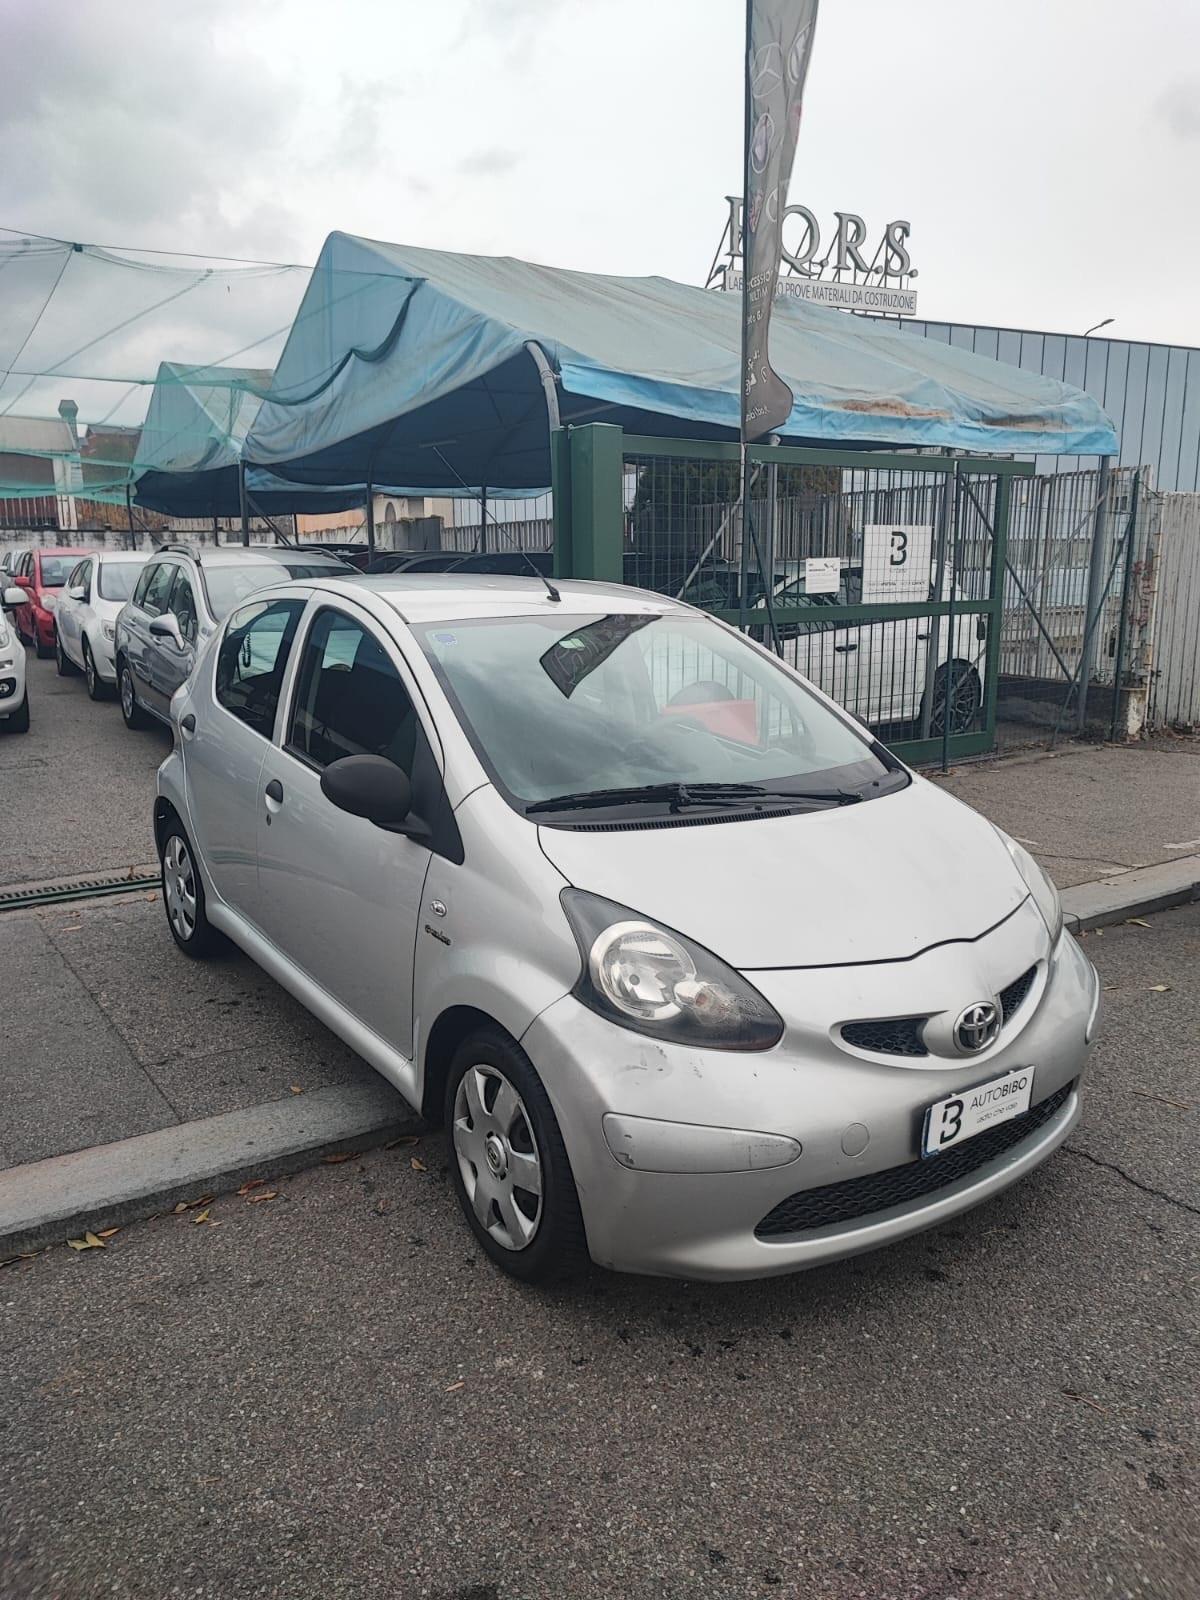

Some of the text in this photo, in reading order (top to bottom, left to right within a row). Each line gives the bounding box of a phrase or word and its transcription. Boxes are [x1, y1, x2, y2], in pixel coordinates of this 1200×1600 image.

[785, 282, 810, 299] PROVE
[812, 285, 851, 303] MATERIALI
[853, 290, 863, 304] DA
[864, 291, 914, 310] COSTRUZIONE
[970, 1076, 1028, 1110] AUTOBIBO
